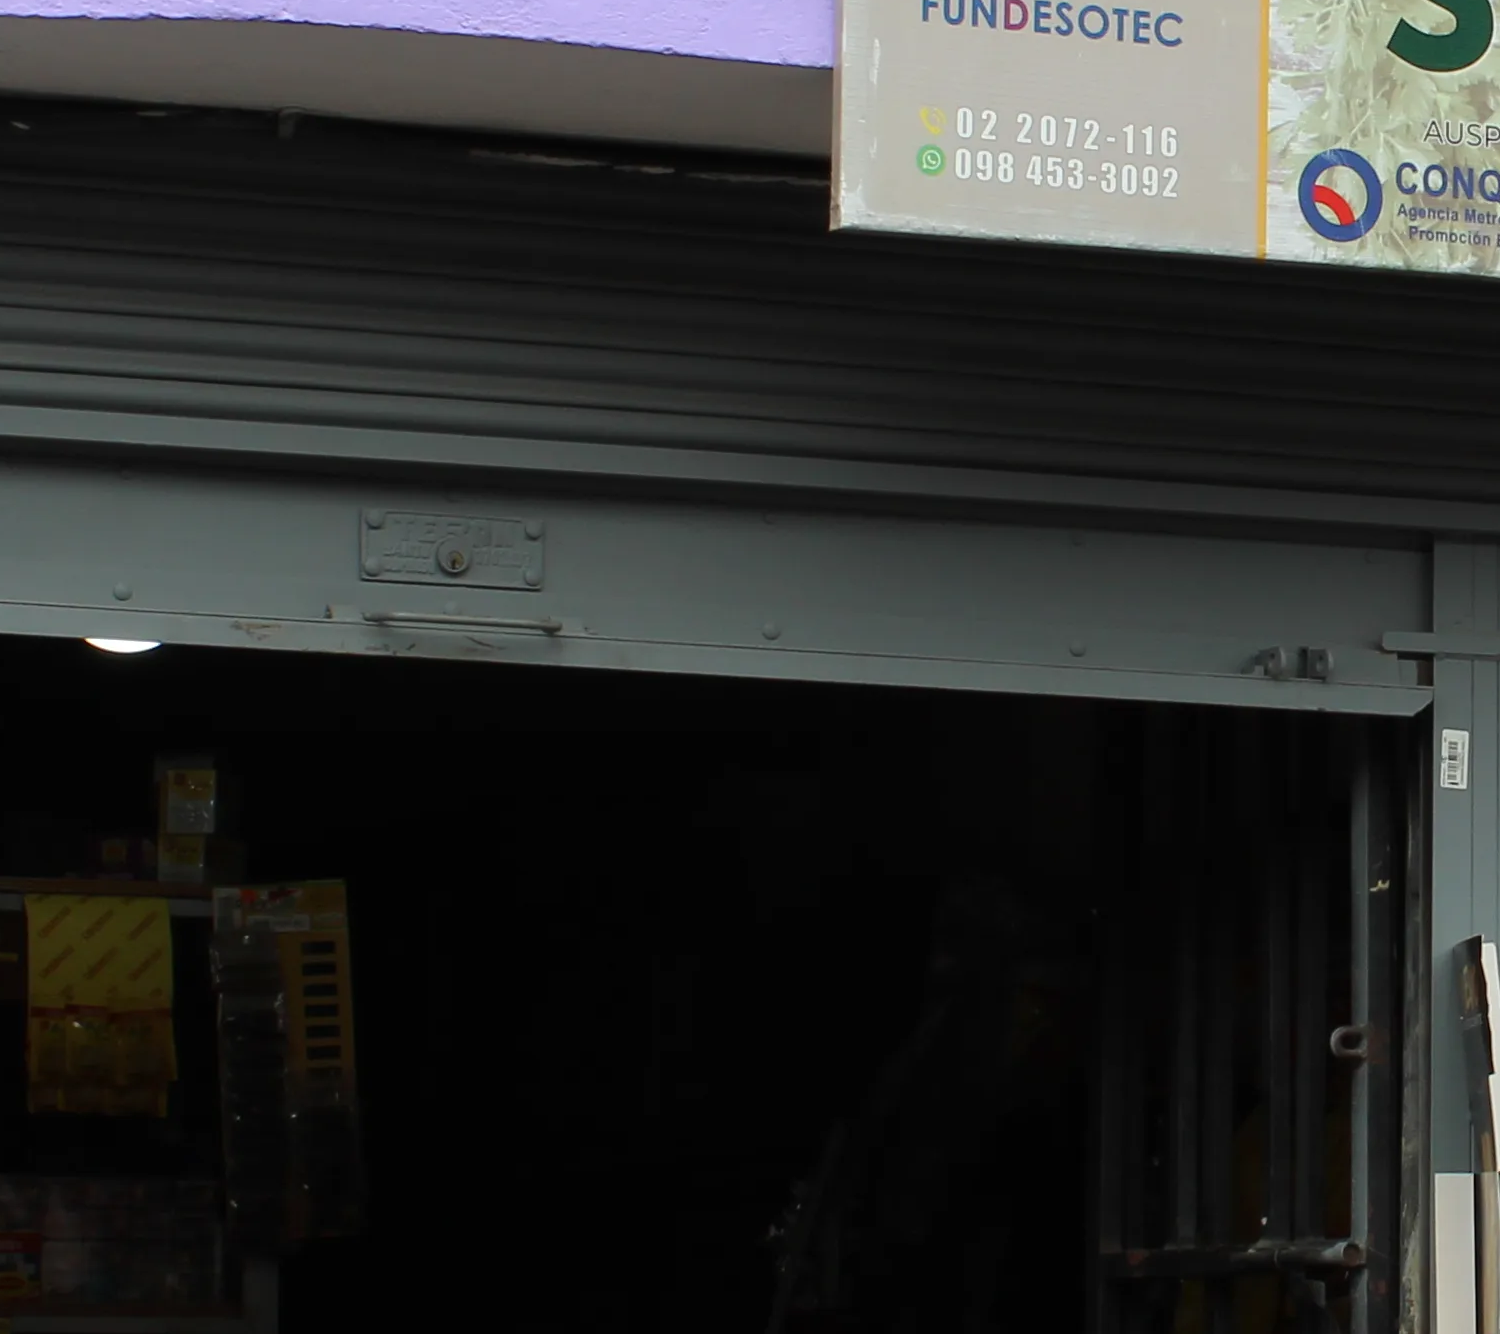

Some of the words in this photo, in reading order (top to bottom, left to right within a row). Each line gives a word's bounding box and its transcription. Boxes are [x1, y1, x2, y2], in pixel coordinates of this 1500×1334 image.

[956, 106, 998, 141] 02
[1016, 113, 1179, 159] 2072-116
[954, 147, 1015, 185] 098
[1026, 154, 1180, 199] 453-3092
[1397, 202, 1459, 223] Agencia
[1409, 226, 1490, 246] Promoción
